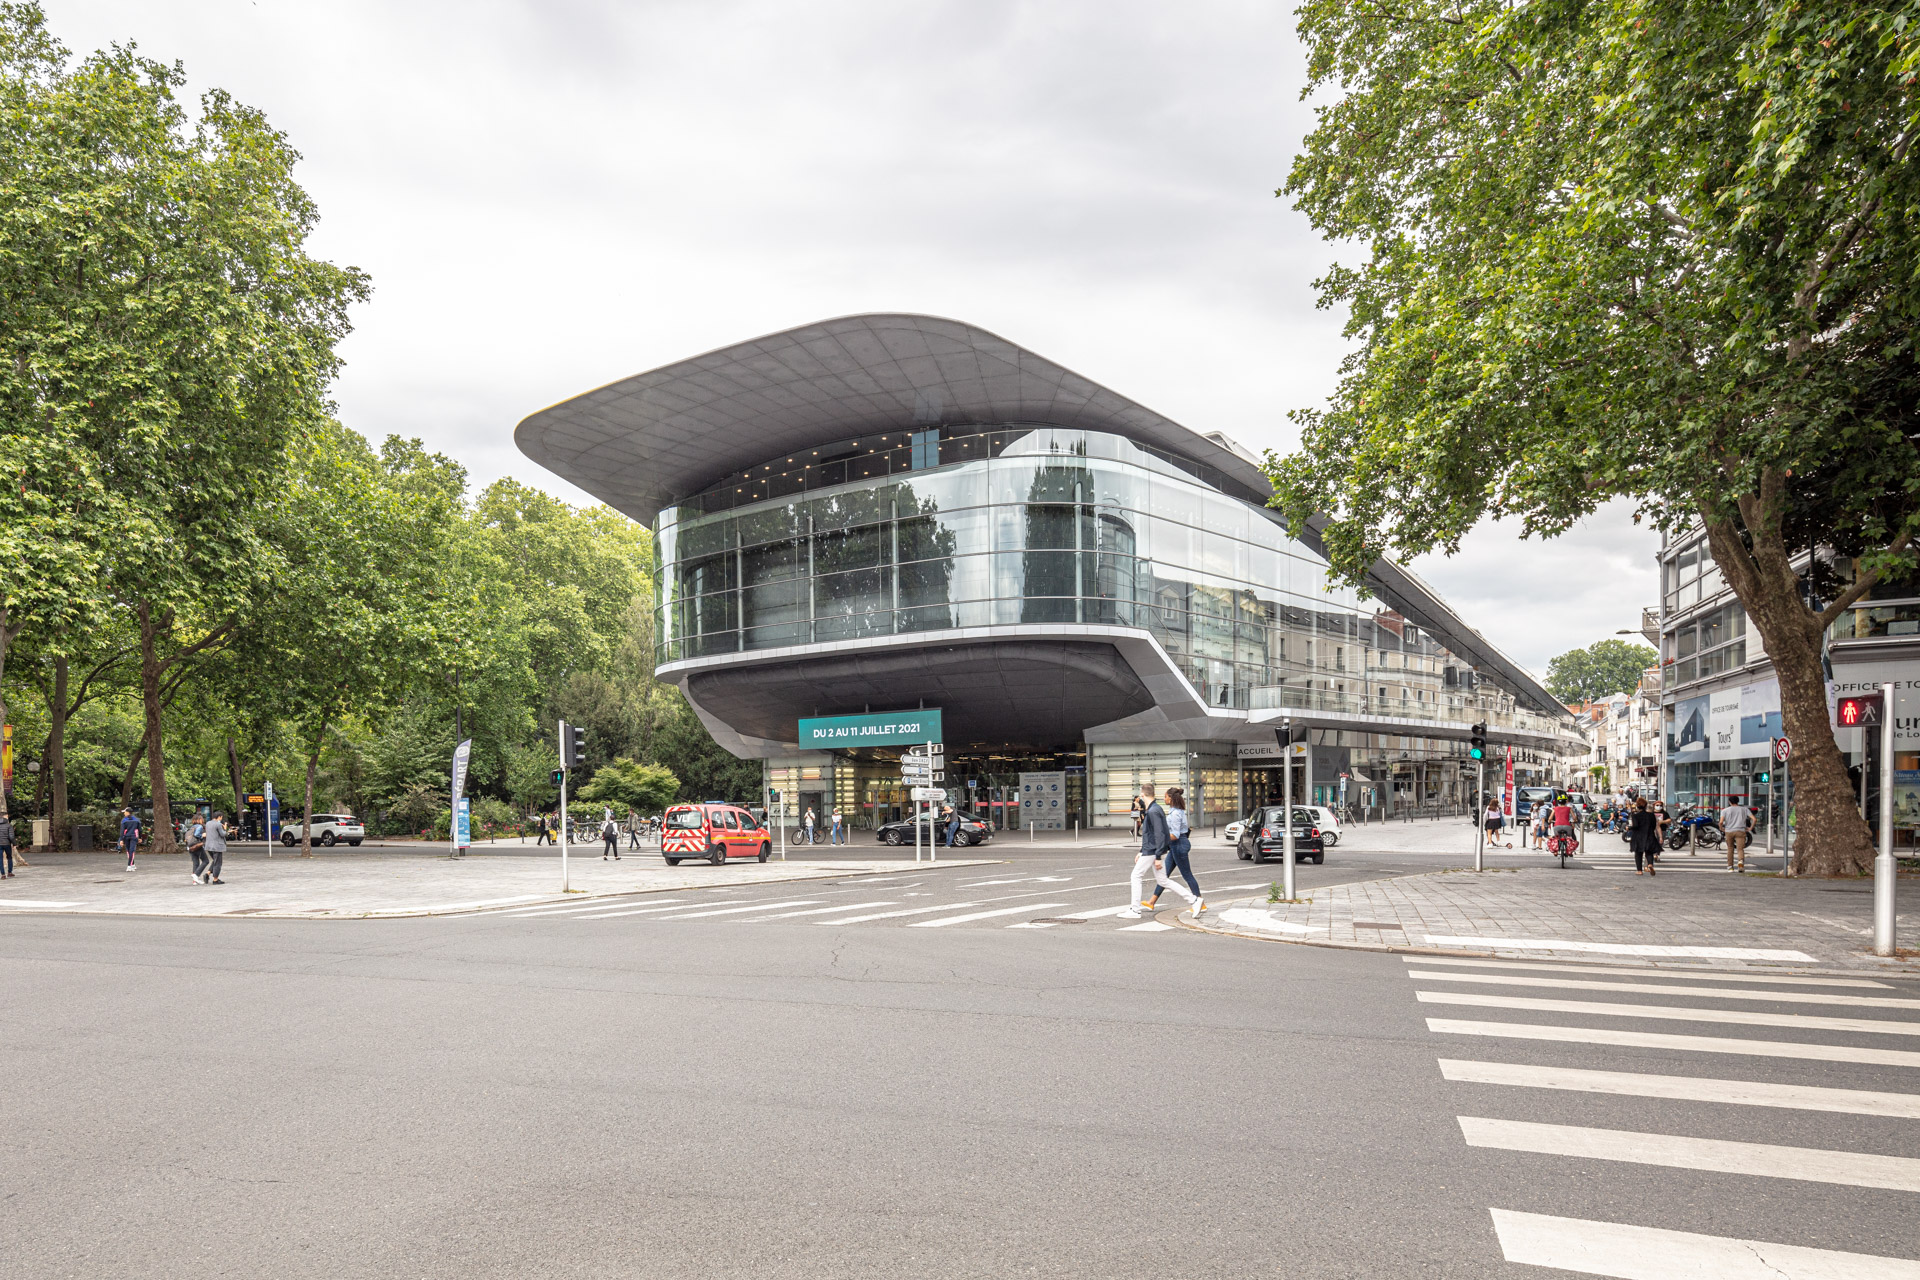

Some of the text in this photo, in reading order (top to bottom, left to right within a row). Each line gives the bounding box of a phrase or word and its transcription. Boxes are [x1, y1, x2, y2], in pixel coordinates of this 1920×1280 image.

[1834, 682, 1880, 693] OFFICE
[1712, 706, 1721, 714] OFFICE
[813, 723, 920, 738] DU 2 AU 11 JUILLET 2021
[1717, 731, 1731, 744] Tours
